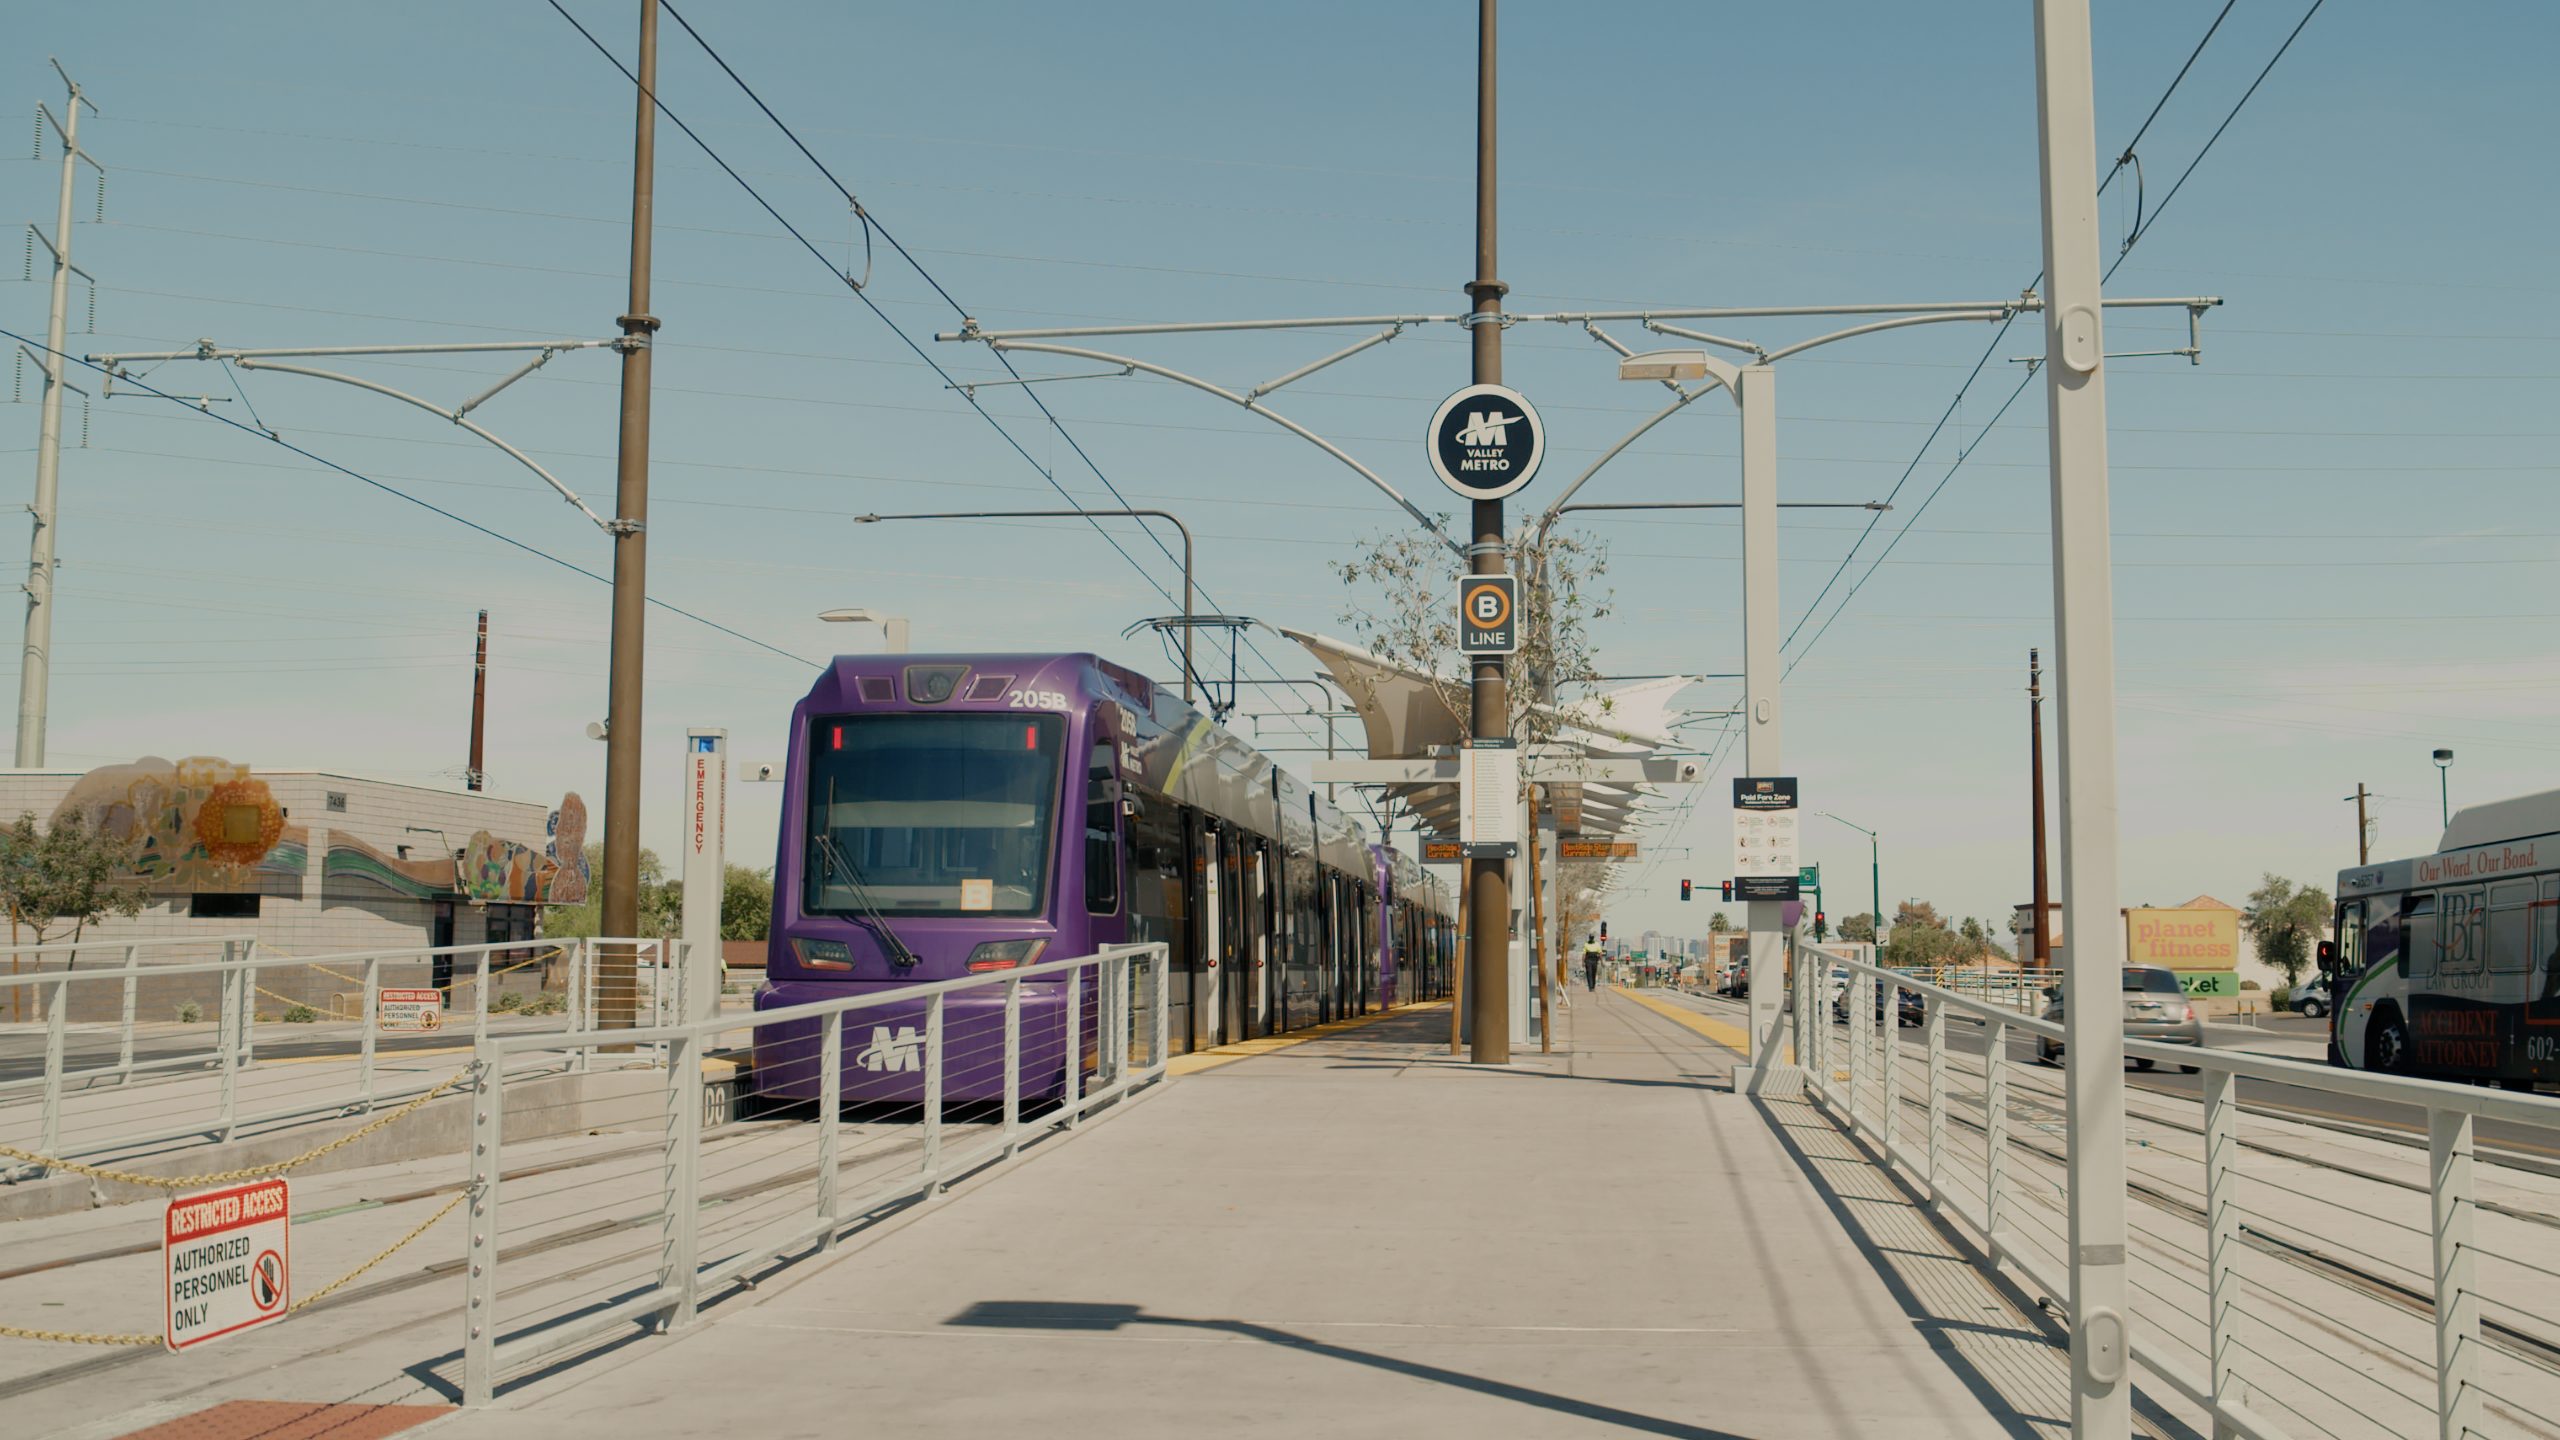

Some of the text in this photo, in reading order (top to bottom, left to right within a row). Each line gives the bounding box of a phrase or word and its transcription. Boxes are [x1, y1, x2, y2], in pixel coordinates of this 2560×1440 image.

[1461, 459, 1510, 471] METRO
[1466, 449, 1504, 458] VALLEY
[1478, 596, 1498, 618] B
[1470, 632, 1505, 645] LINE
[1009, 690, 1067, 709] 205B
[695, 759, 705, 854] EMERGENCY
[2420, 843, 2538, 882] Our Word. Our Bond.
[2138, 919, 2216, 943] planet
[2149, 939, 2231, 958] fitness
[2179, 976, 2220, 993] cket
[2420, 1009, 2498, 1037] ACCIDENT
[2416, 1040, 2501, 1068] ATTORNEY
[705, 1086, 726, 1127] DO
[172, 1186, 283, 1236] RESTRICTED ACCESS
[174, 1236, 250, 1274] AUTHORIZED
[175, 1265, 249, 1302] PERSONNEL
[175, 1302, 208, 1331] ONLY
